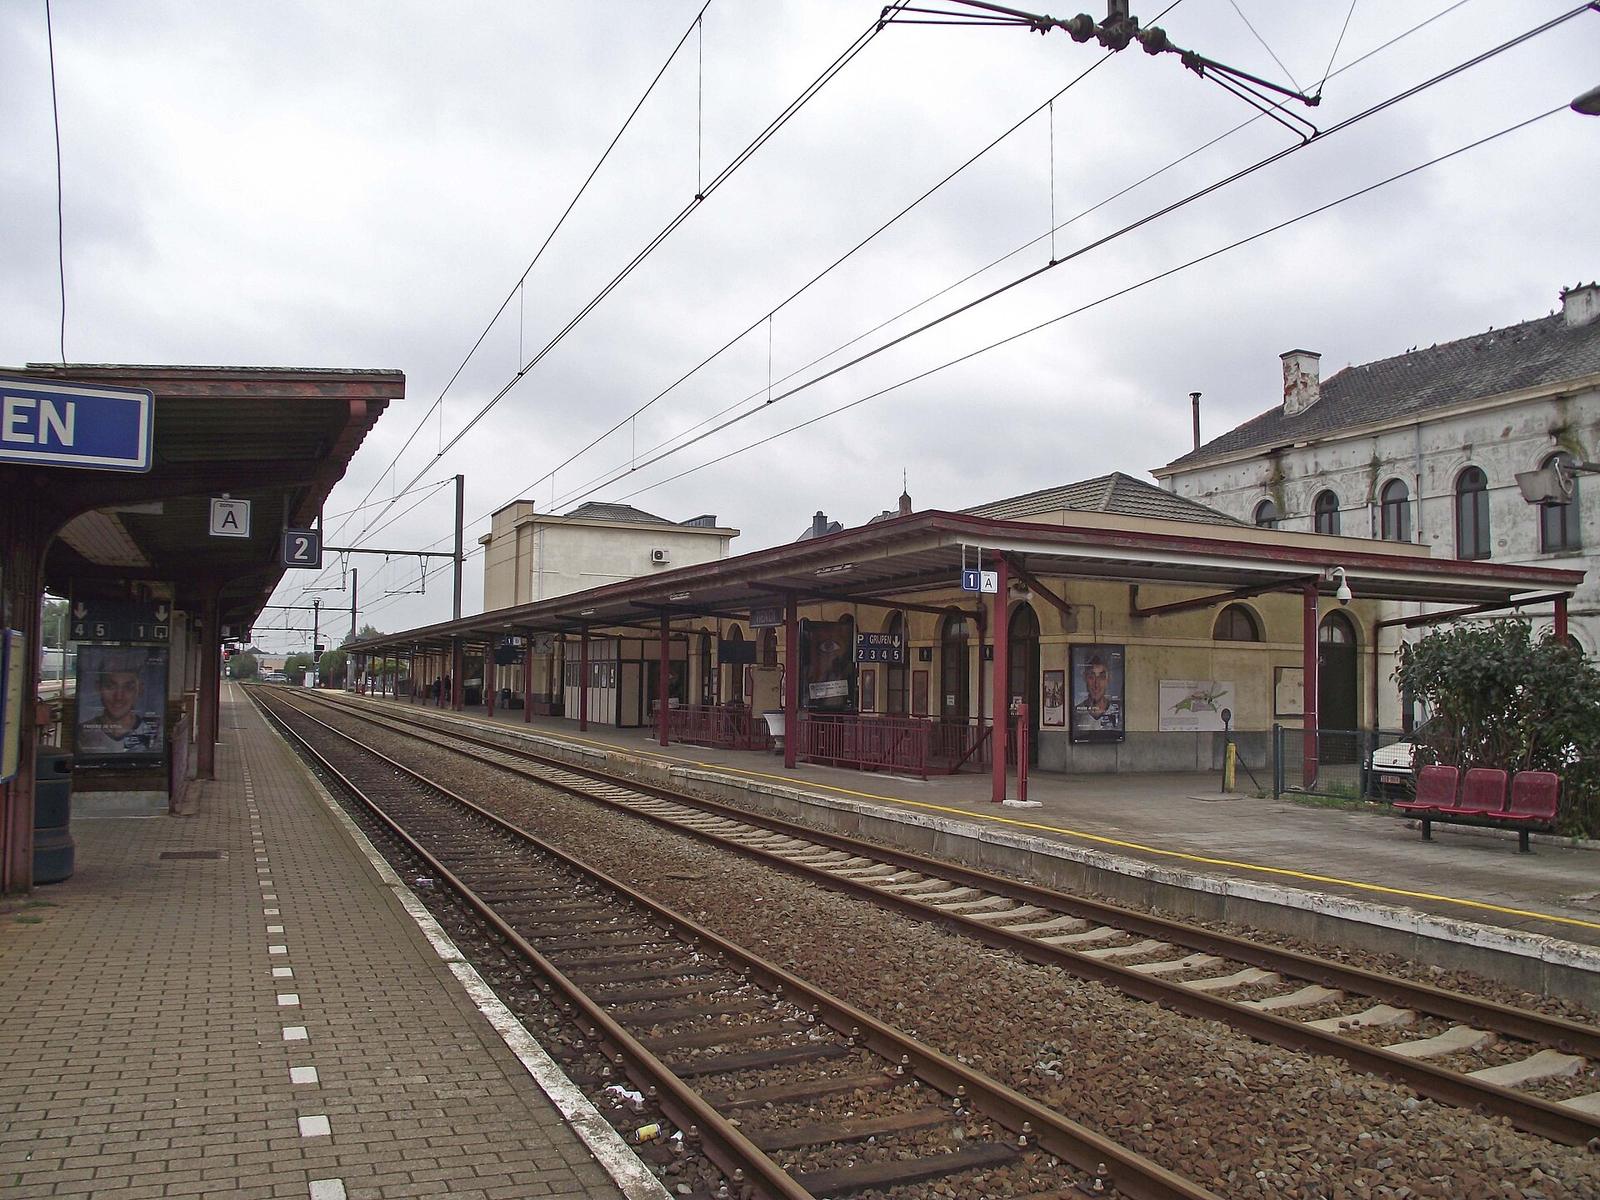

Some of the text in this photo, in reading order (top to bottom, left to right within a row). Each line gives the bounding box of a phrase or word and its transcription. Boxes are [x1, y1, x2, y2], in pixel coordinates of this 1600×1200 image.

[2, 396, 75, 446] EN
[222, 511, 238, 529] A
[294, 538, 308, 560] 2
[969, 573, 974, 587] 1
[985, 577, 993, 588] A
[75, 624, 105, 636] 4 5
[139, 625, 144, 638] 1
[858, 635, 864, 644] P
[858, 650, 899, 660] 2 3 4 5
